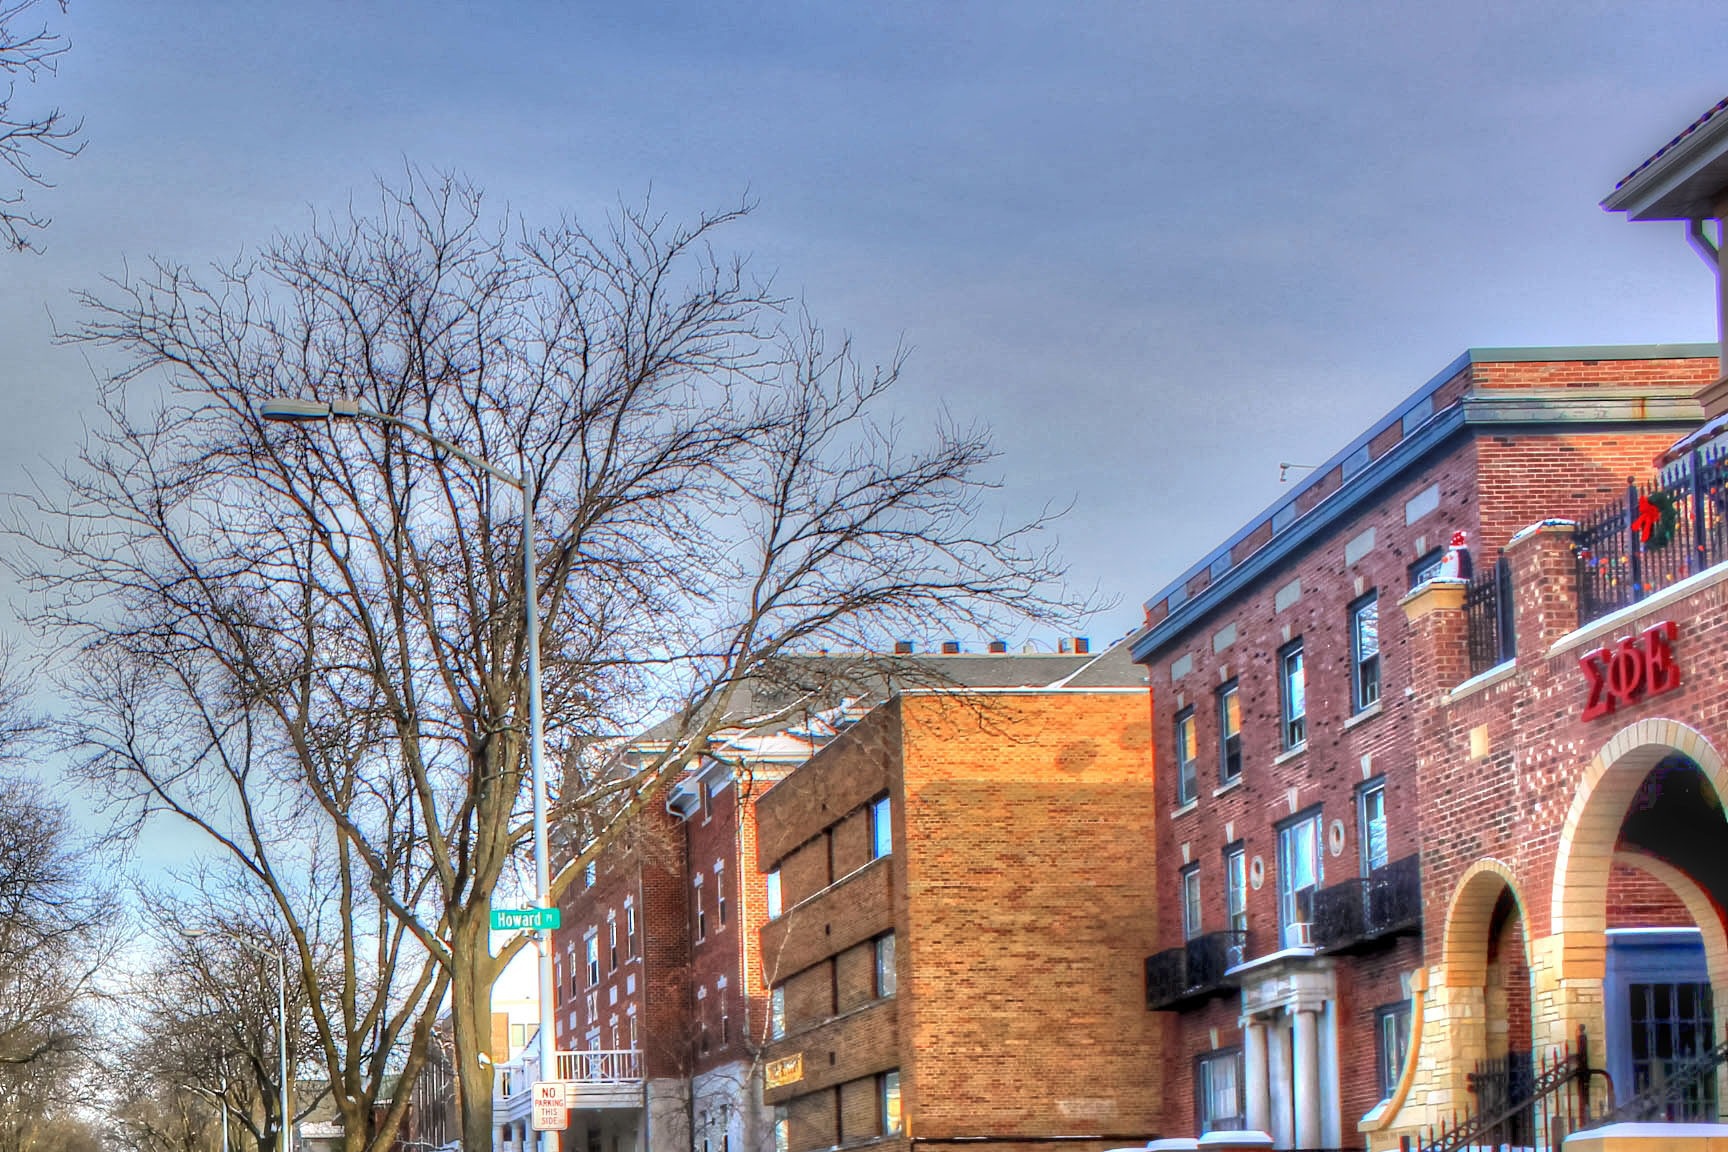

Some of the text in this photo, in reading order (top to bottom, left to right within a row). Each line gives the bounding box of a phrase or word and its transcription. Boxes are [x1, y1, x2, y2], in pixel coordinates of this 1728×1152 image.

[497, 911, 542, 928] Howard
[541, 1087, 556, 1099] NO
[534, 1099, 564, 1107] PARKING
[541, 1107, 558, 1116] THIS
[541, 1116, 557, 1125] SIDE
